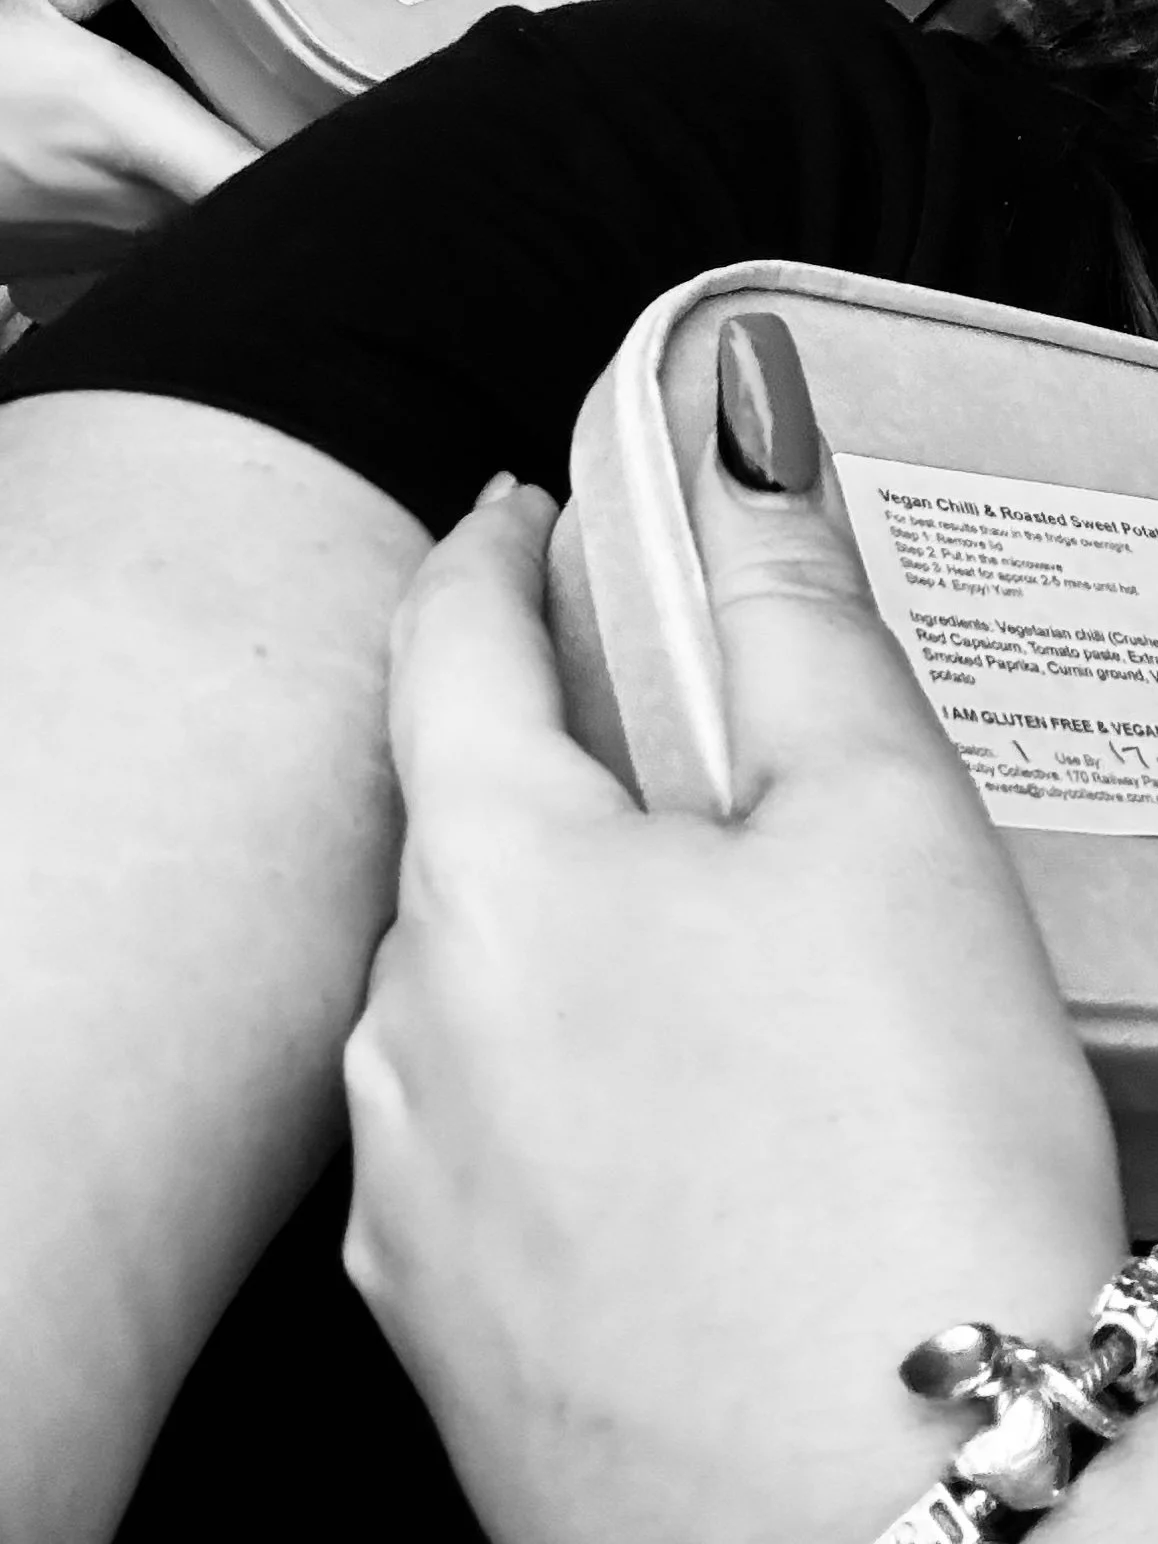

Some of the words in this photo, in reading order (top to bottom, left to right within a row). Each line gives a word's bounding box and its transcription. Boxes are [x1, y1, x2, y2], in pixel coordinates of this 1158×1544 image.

[878, 488, 932, 510] Vegan
[936, 498, 979, 516] Chilli
[984, 504, 997, 517] &
[1000, 506, 1068, 527] Roasted
[1070, 515, 1119, 533] Sweet
[915, 626, 947, 645] Red
[950, 633, 1027, 655] Capsicum,
[1027, 641, 1080, 659] Tomato
[995, 619, 1072, 639] Vegetarian
[922, 647, 983, 667] Smoked
[985, 655, 1045, 675] Paprika,
[1047, 661, 1093, 677] Cumin
[953, 707, 978, 722] AM
[981, 711, 1048, 730] GLUTEN
[1050, 717, 1094, 734] FREE
[1096, 720, 1109, 735] &
[1066, 770, 1089, 784] 170
